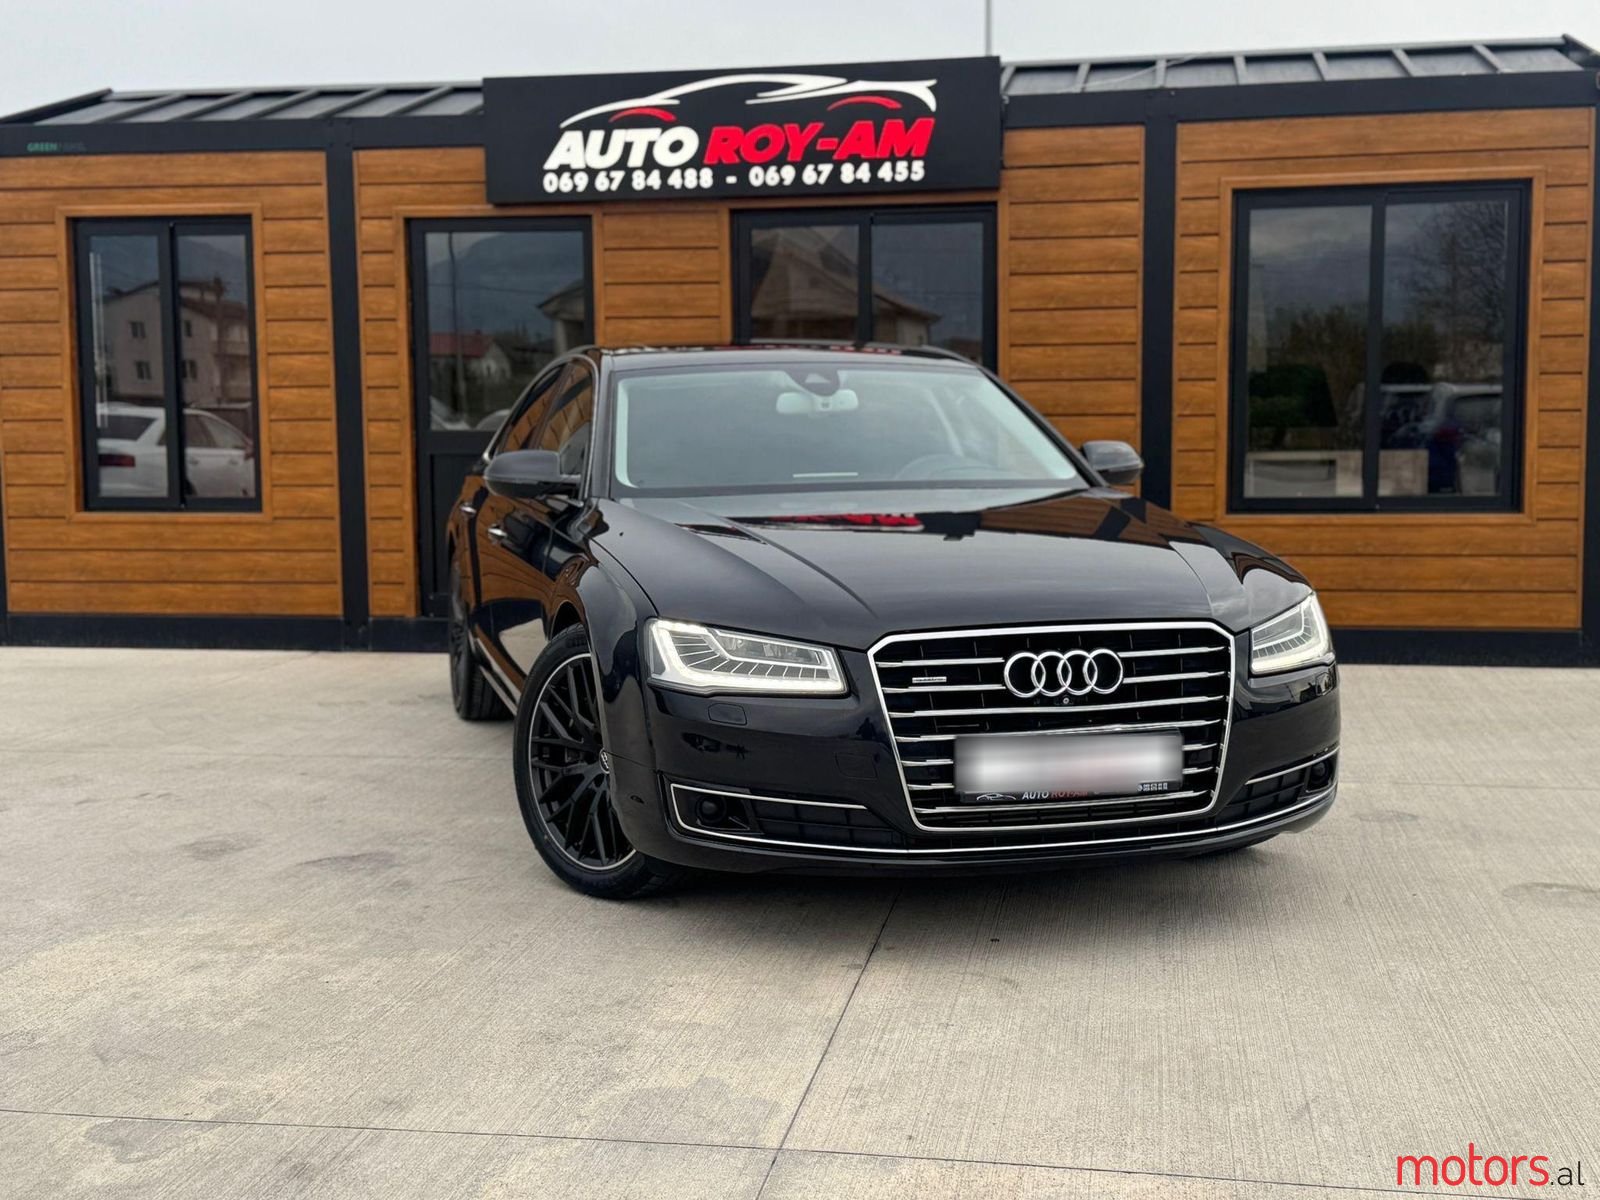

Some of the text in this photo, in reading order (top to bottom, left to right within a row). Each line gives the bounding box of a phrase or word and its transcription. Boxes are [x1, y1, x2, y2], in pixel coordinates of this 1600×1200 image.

[542, 117, 935, 171] AUTO ROY-AM
[542, 160, 925, 193] 069 67 84 488 - 069 67 84 455
[1021, 790, 1050, 800] AUTO
